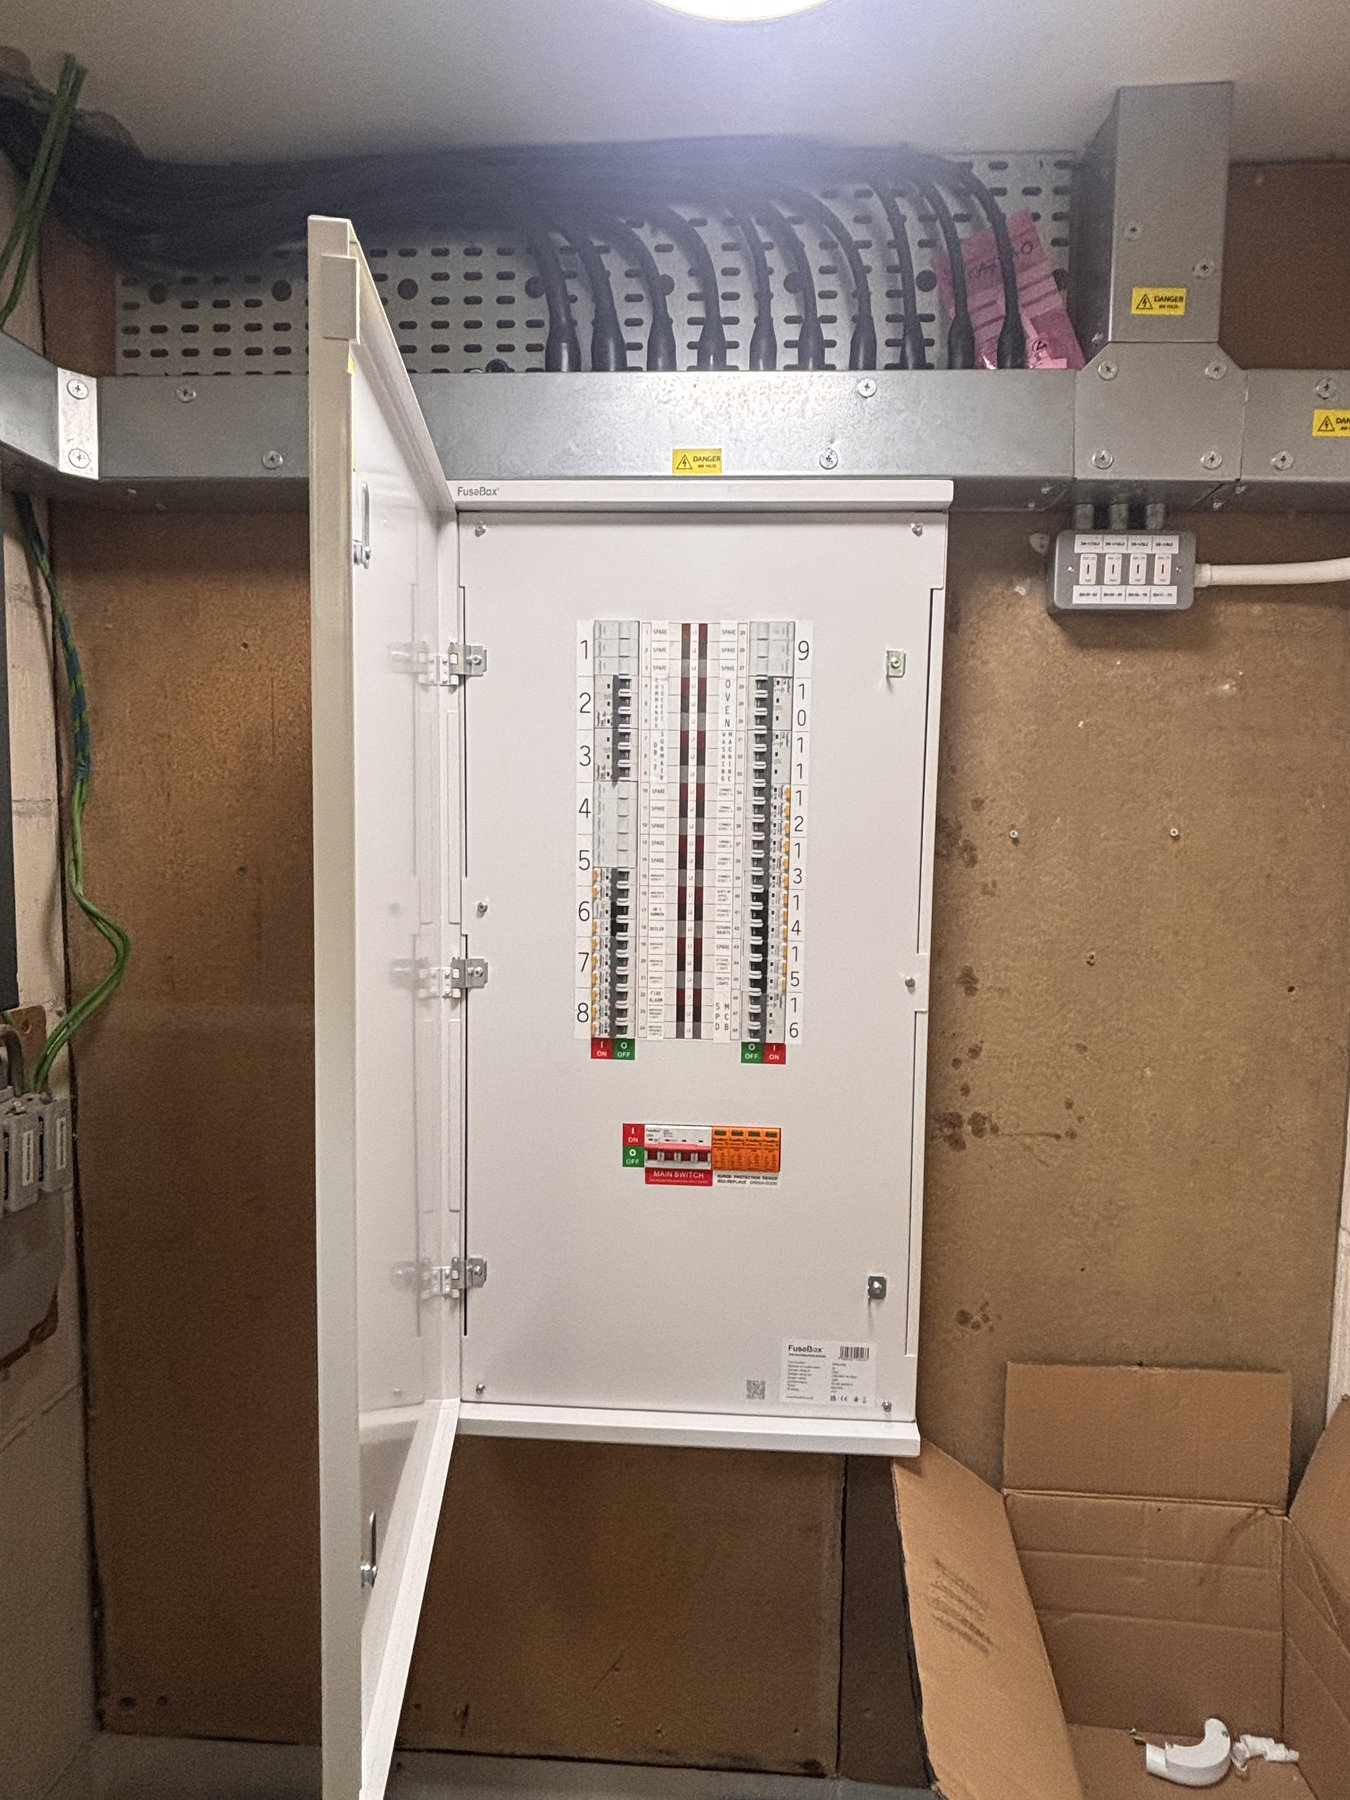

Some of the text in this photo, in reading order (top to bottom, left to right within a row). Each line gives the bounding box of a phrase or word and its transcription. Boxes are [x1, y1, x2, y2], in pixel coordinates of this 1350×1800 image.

[457, 486, 498, 496] FuseBox
[580, 640, 588, 659] 1
[798, 640, 810, 661] 9
[579, 693, 591, 714] 2
[797, 684, 806, 726] 10
[579, 746, 591, 766] 3
[797, 738, 804, 778] 11
[579, 798, 591, 819] 4
[794, 790, 804, 832] 12
[579, 850, 590, 870] 5
[793, 843, 802, 884] 13
[578, 901, 590, 921] 6
[792, 895, 801, 935] 14
[578, 952, 589, 972] 7
[791, 947, 800, 986] 15
[577, 1002, 589, 1022] 8
[789, 998, 799, 1038] 16
[788, 1344, 822, 1353] FuseBox
